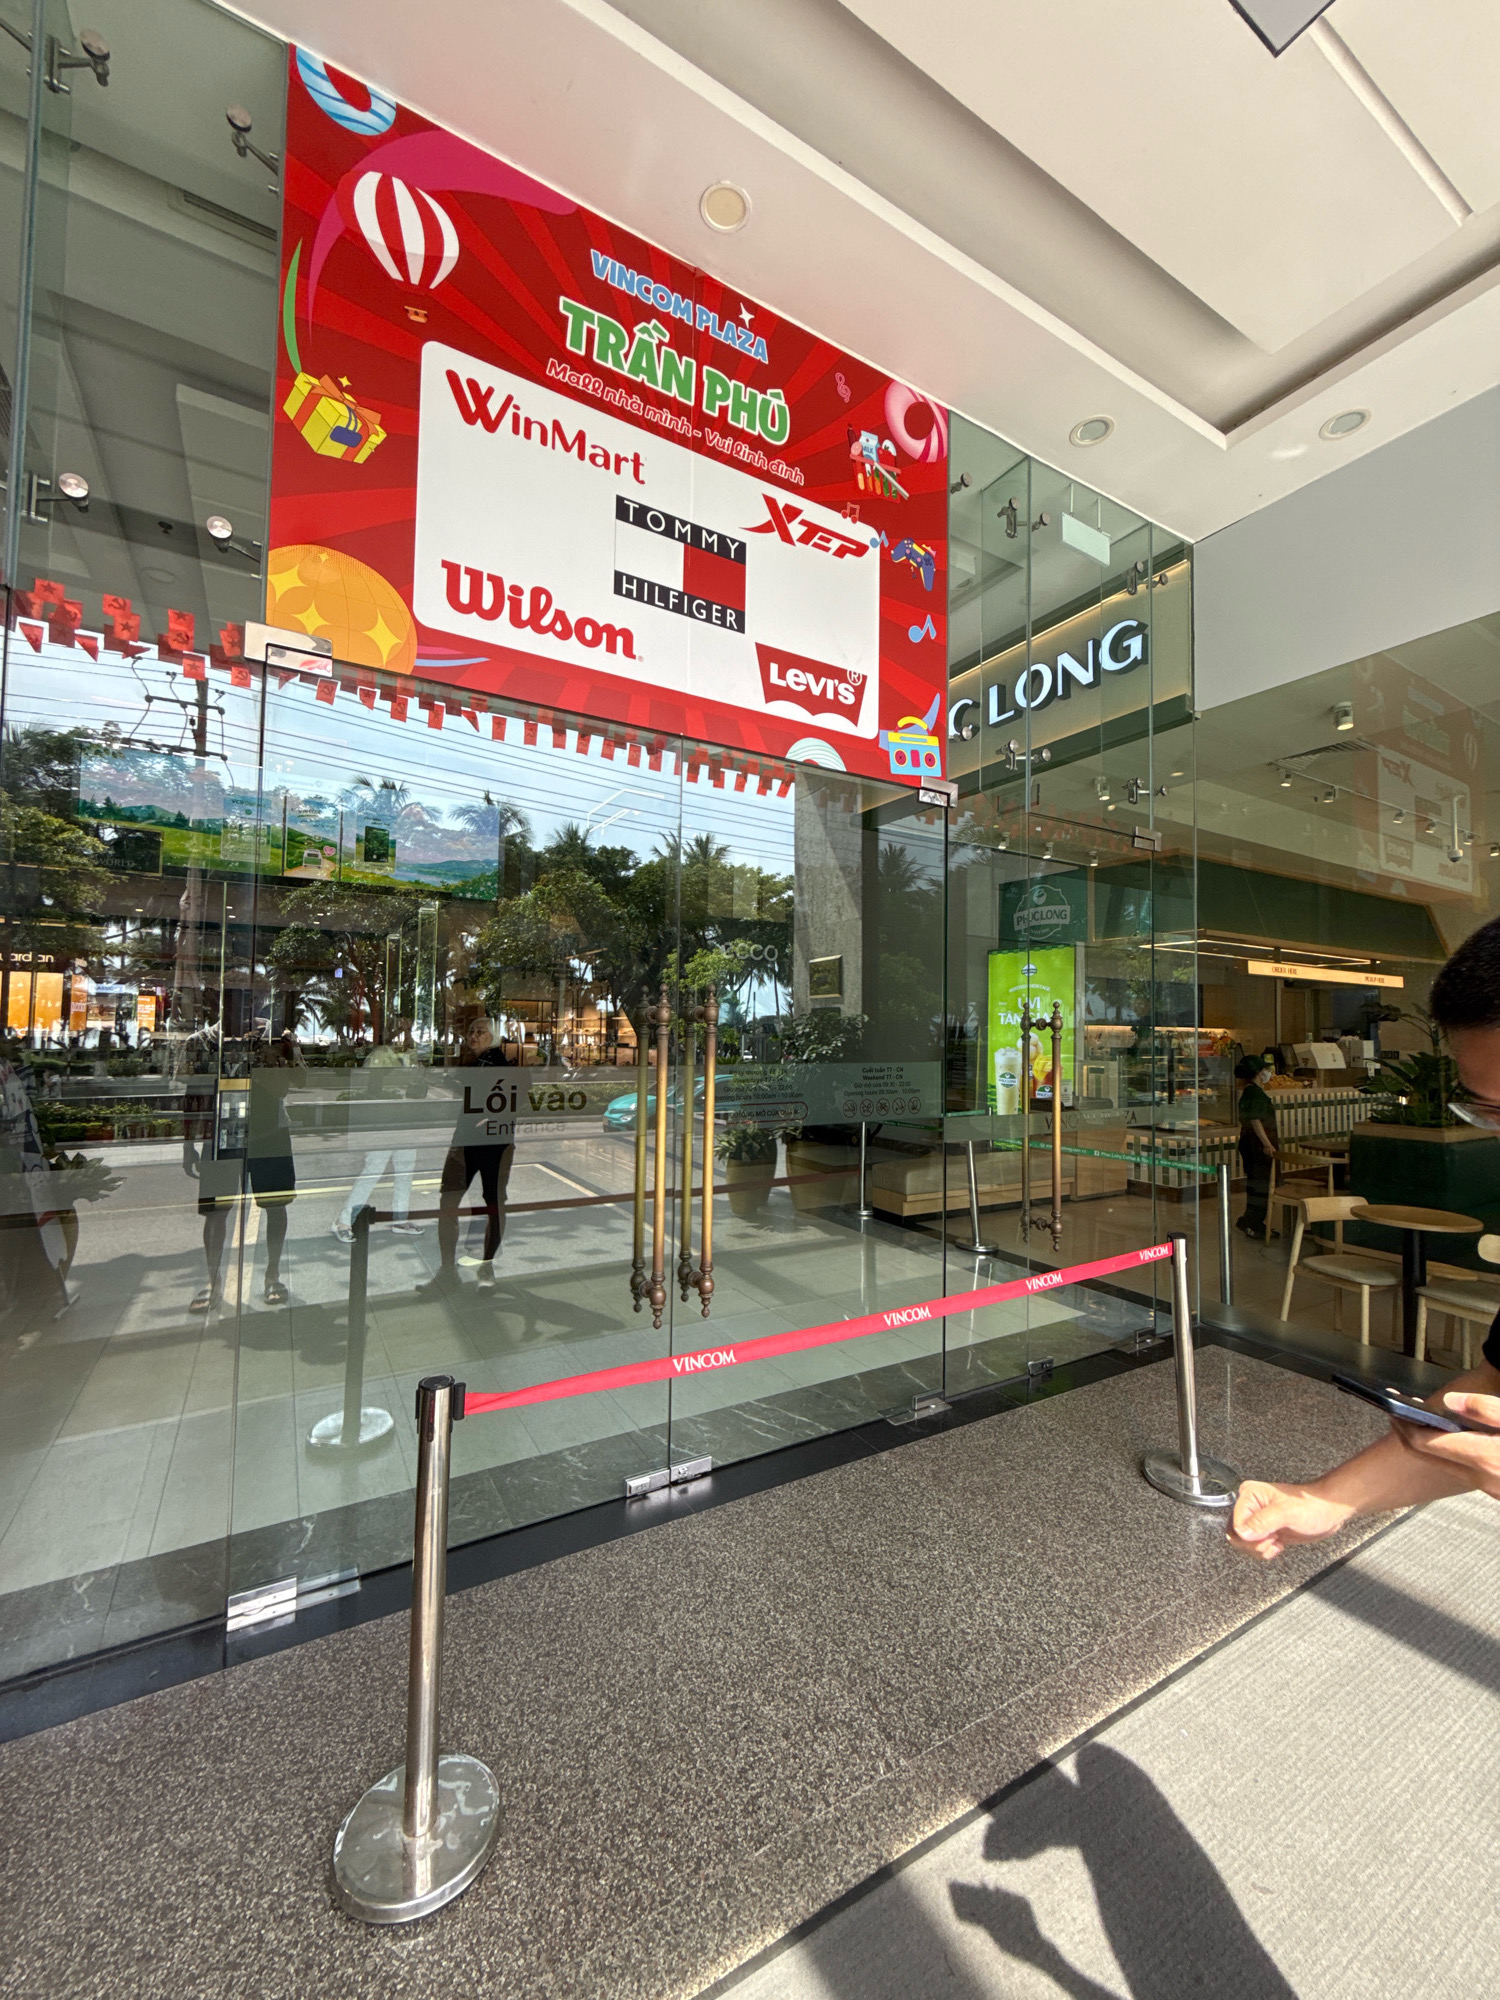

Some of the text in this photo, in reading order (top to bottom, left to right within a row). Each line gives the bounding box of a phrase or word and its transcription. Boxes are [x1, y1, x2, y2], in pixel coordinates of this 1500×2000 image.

[591, 249, 769, 364] VINCOM PLAZA
[560, 296, 791, 445] TRẦN PHÚ
[445, 369, 646, 485] WinMart
[546, 358, 602, 397] Mall
[603, 385, 643, 415] nhà
[646, 403, 692, 437] mình
[705, 428, 733, 455] Vui
[733, 436, 767, 470] linh
[769, 459, 805, 486] đình
[624, 500, 740, 559] TOMMY
[738, 493, 870, 559] XTEP
[441, 559, 637, 660] Wilson
[622, 575, 738, 630] HILFIGER
[989, 619, 1145, 727] LONG
[0, 951, 55, 963] ardan
[463, 1079, 587, 1114] Lối vào
[486, 1120, 566, 1136] Entrance
[1025, 1271, 1063, 1291] VINCOM
[1138, 1245, 1170, 1262] VINCOM
[883, 1305, 932, 1328] VINCOM
[672, 1348, 737, 1374] VINCOM
